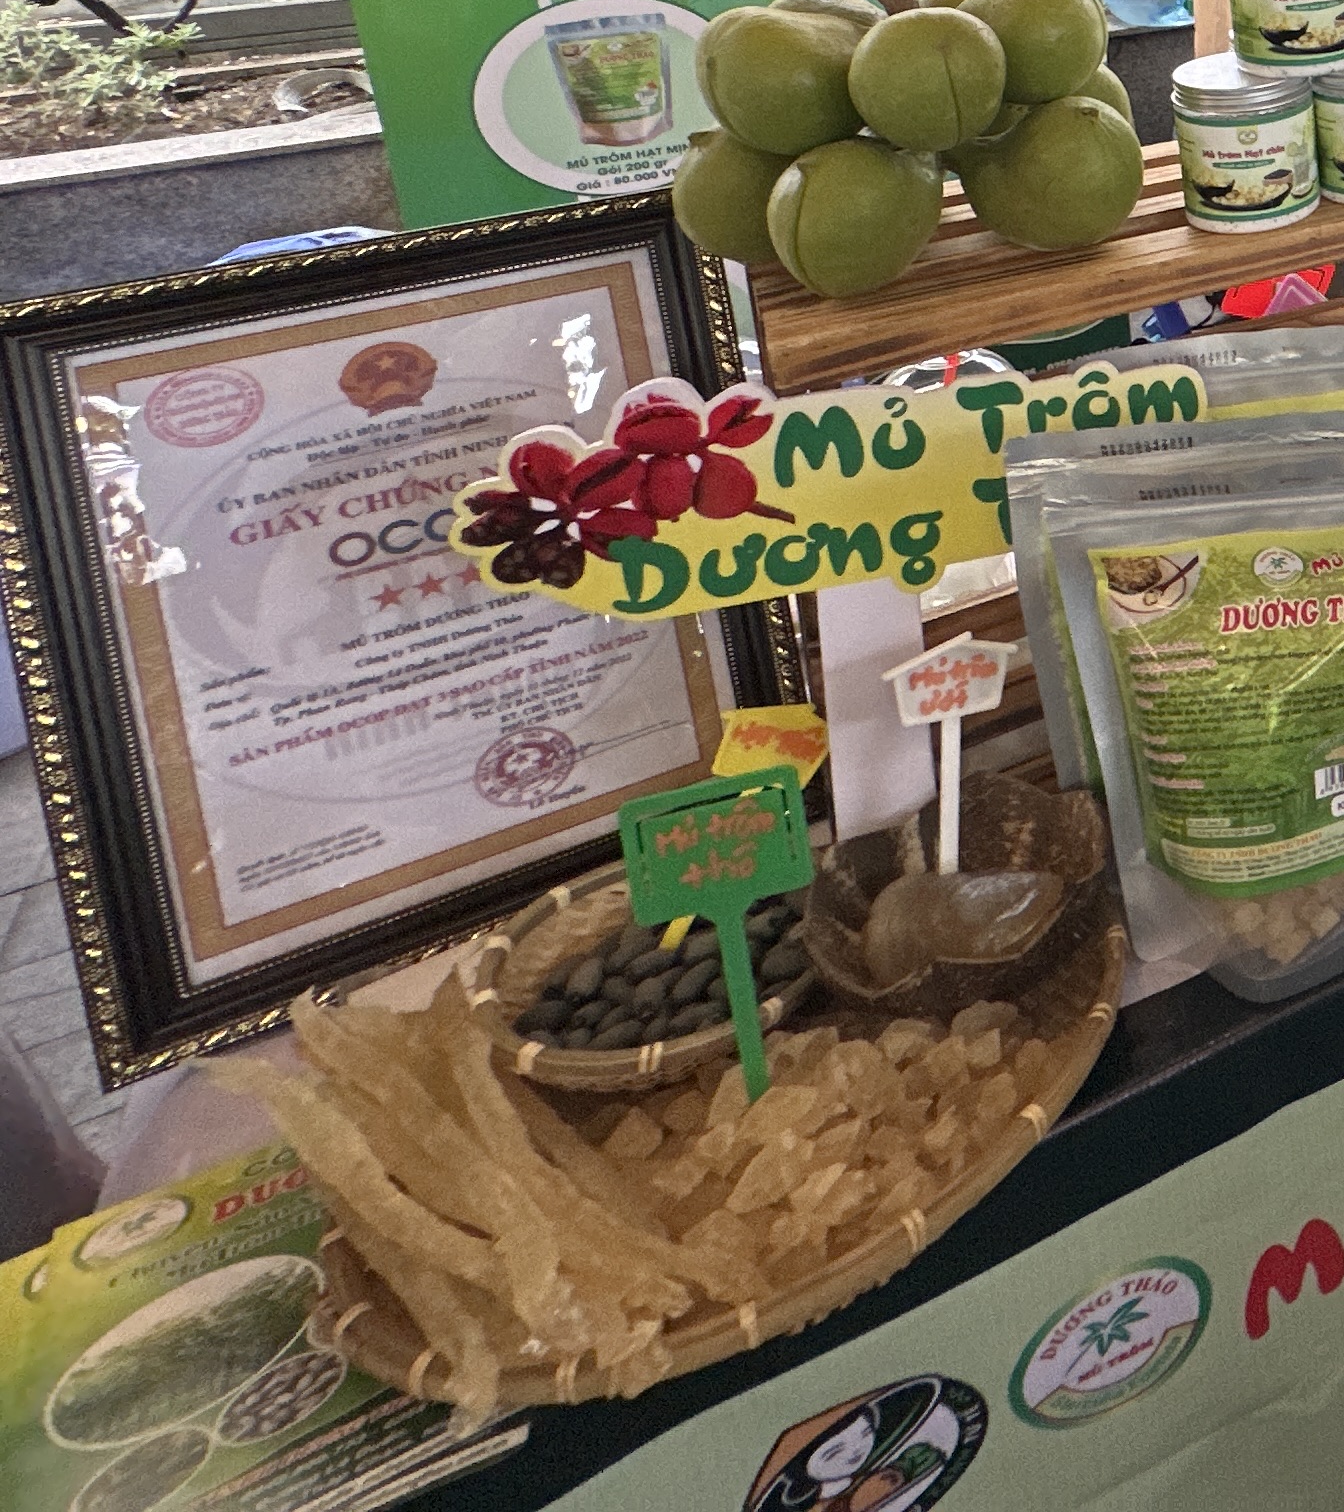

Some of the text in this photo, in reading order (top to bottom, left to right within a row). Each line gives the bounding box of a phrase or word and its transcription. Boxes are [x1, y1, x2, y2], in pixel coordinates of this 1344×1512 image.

[626, 161, 650, 172] 200
[774, 395, 925, 487] Mủ
[957, 372, 1199, 453] Trôm
[609, 508, 944, 614] Dương
[1310, 551, 1344, 576] Mủ
[1221, 595, 1320, 634] DƯƠNG
